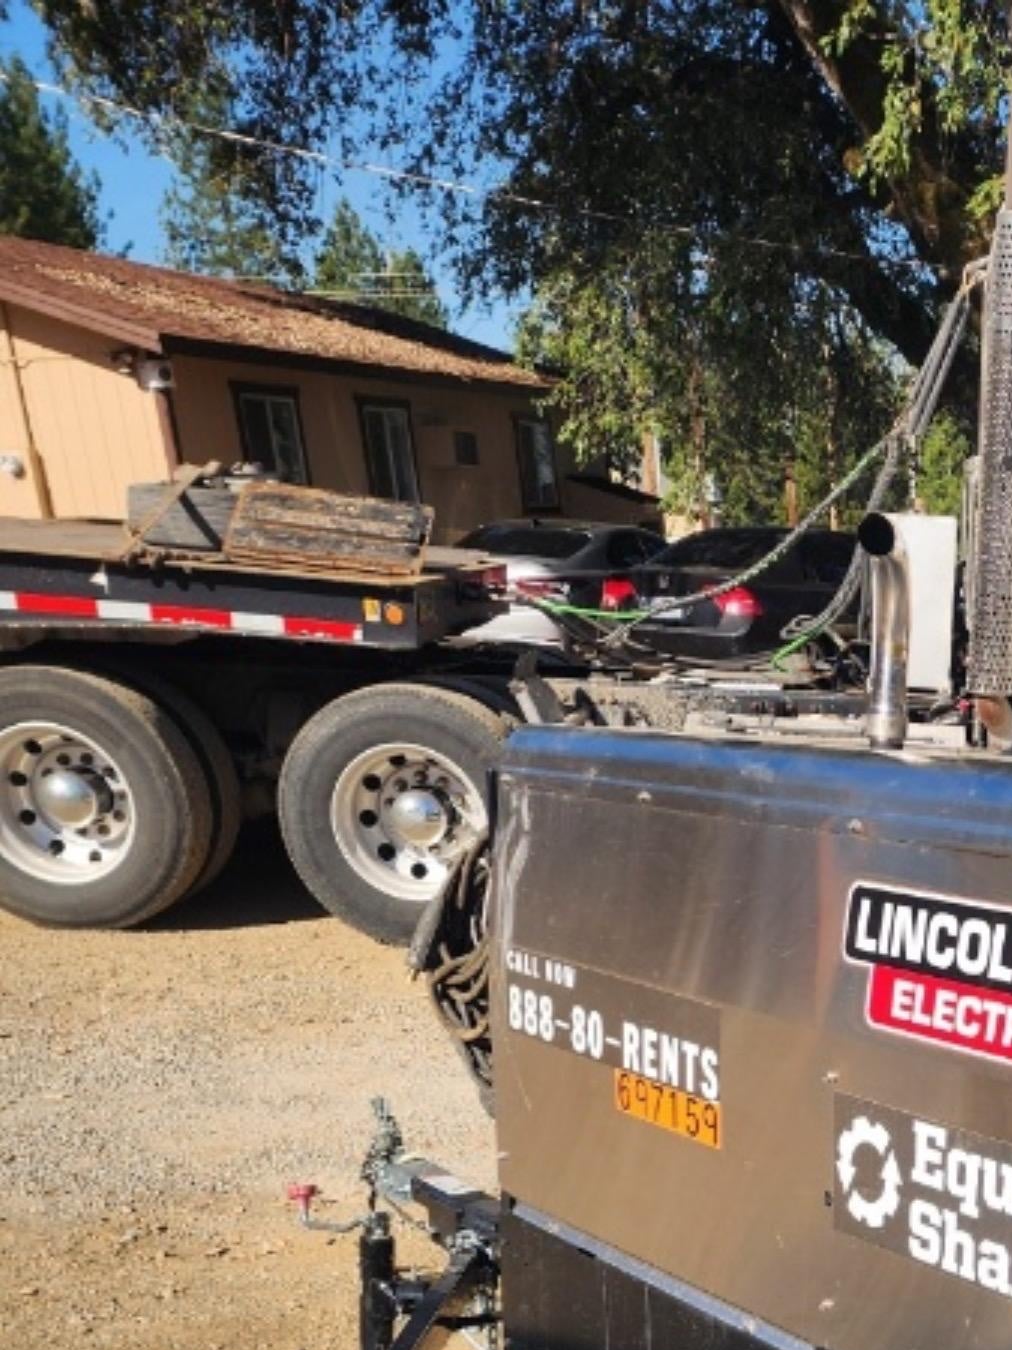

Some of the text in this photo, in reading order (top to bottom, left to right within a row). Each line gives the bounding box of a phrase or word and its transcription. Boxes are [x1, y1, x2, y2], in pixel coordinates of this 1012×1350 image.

[506, 950, 540, 979] CALL
[508, 984, 719, 1101] 888-80-RENTS
[617, 1072, 717, 1144] 697159
